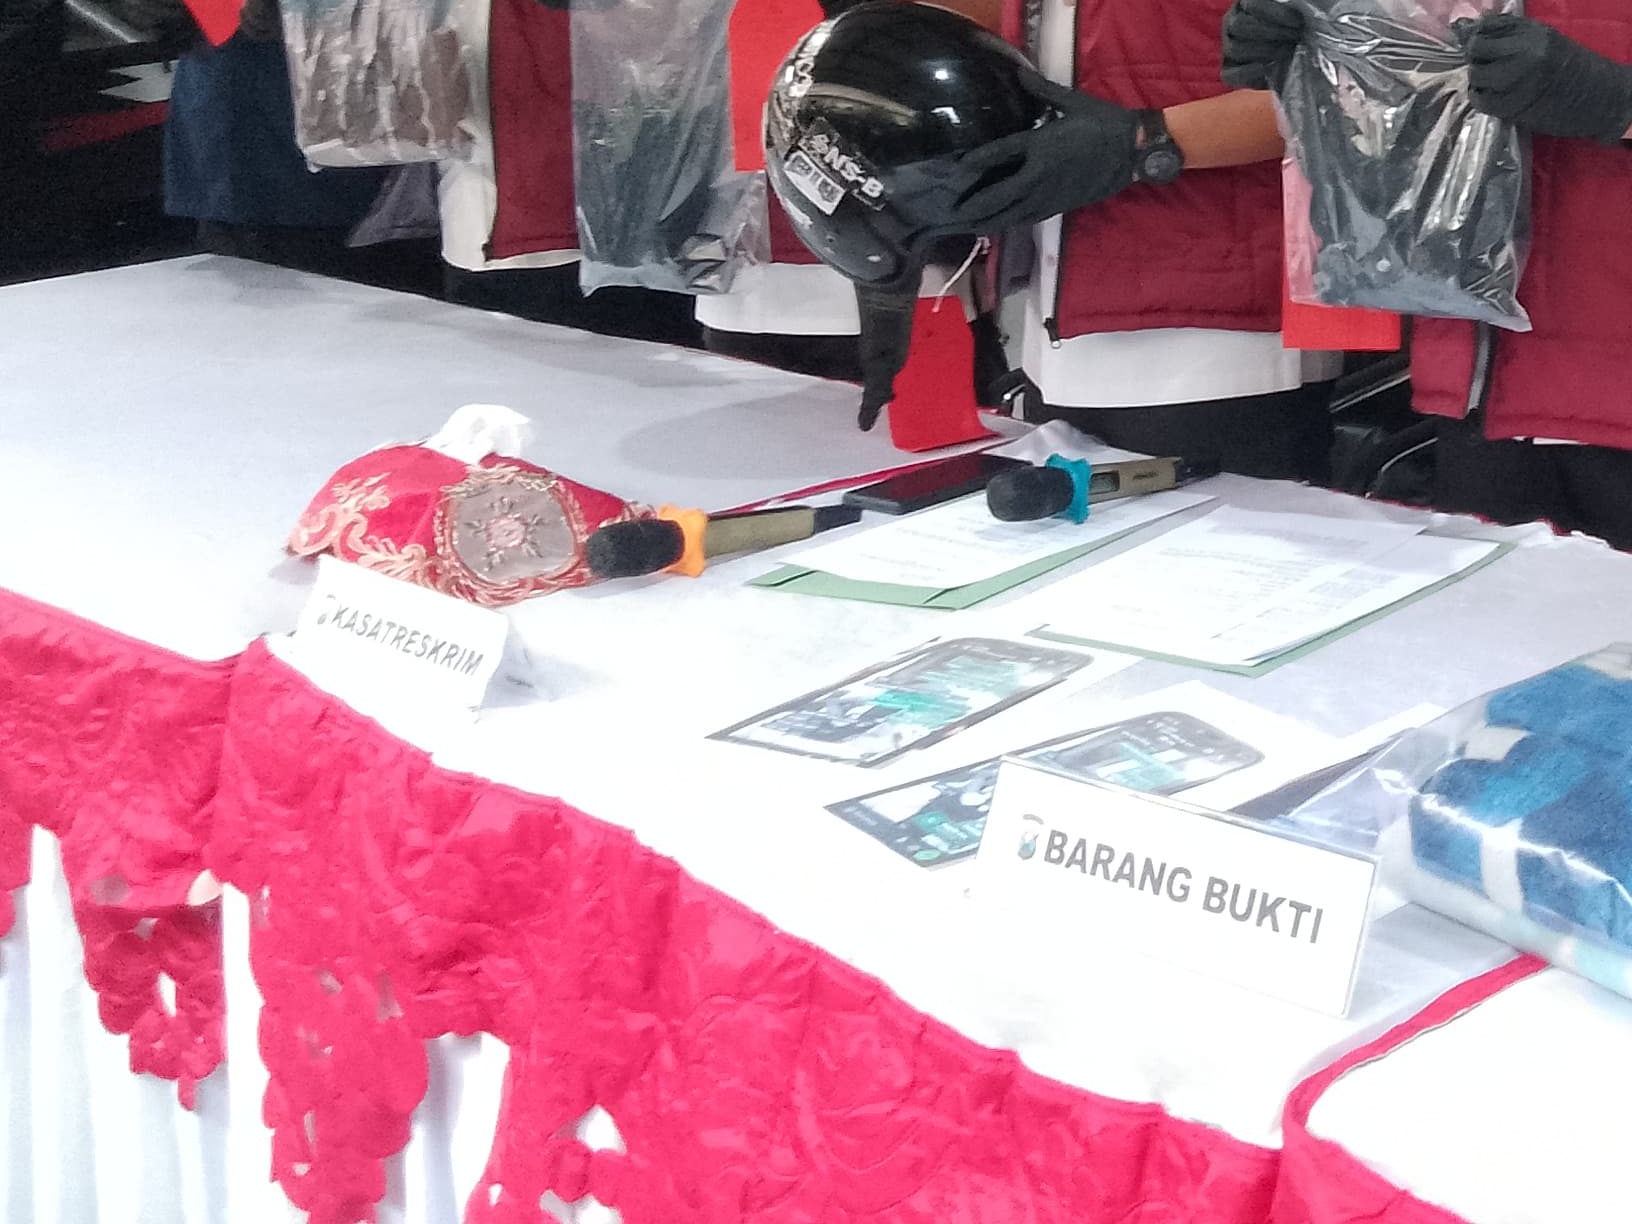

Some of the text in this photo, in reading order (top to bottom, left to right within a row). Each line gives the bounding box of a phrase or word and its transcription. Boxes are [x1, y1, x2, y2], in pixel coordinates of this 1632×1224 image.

[331, 605, 484, 676] KASATRESKRIM
[1044, 829, 1323, 944] BARANG BUKTI
